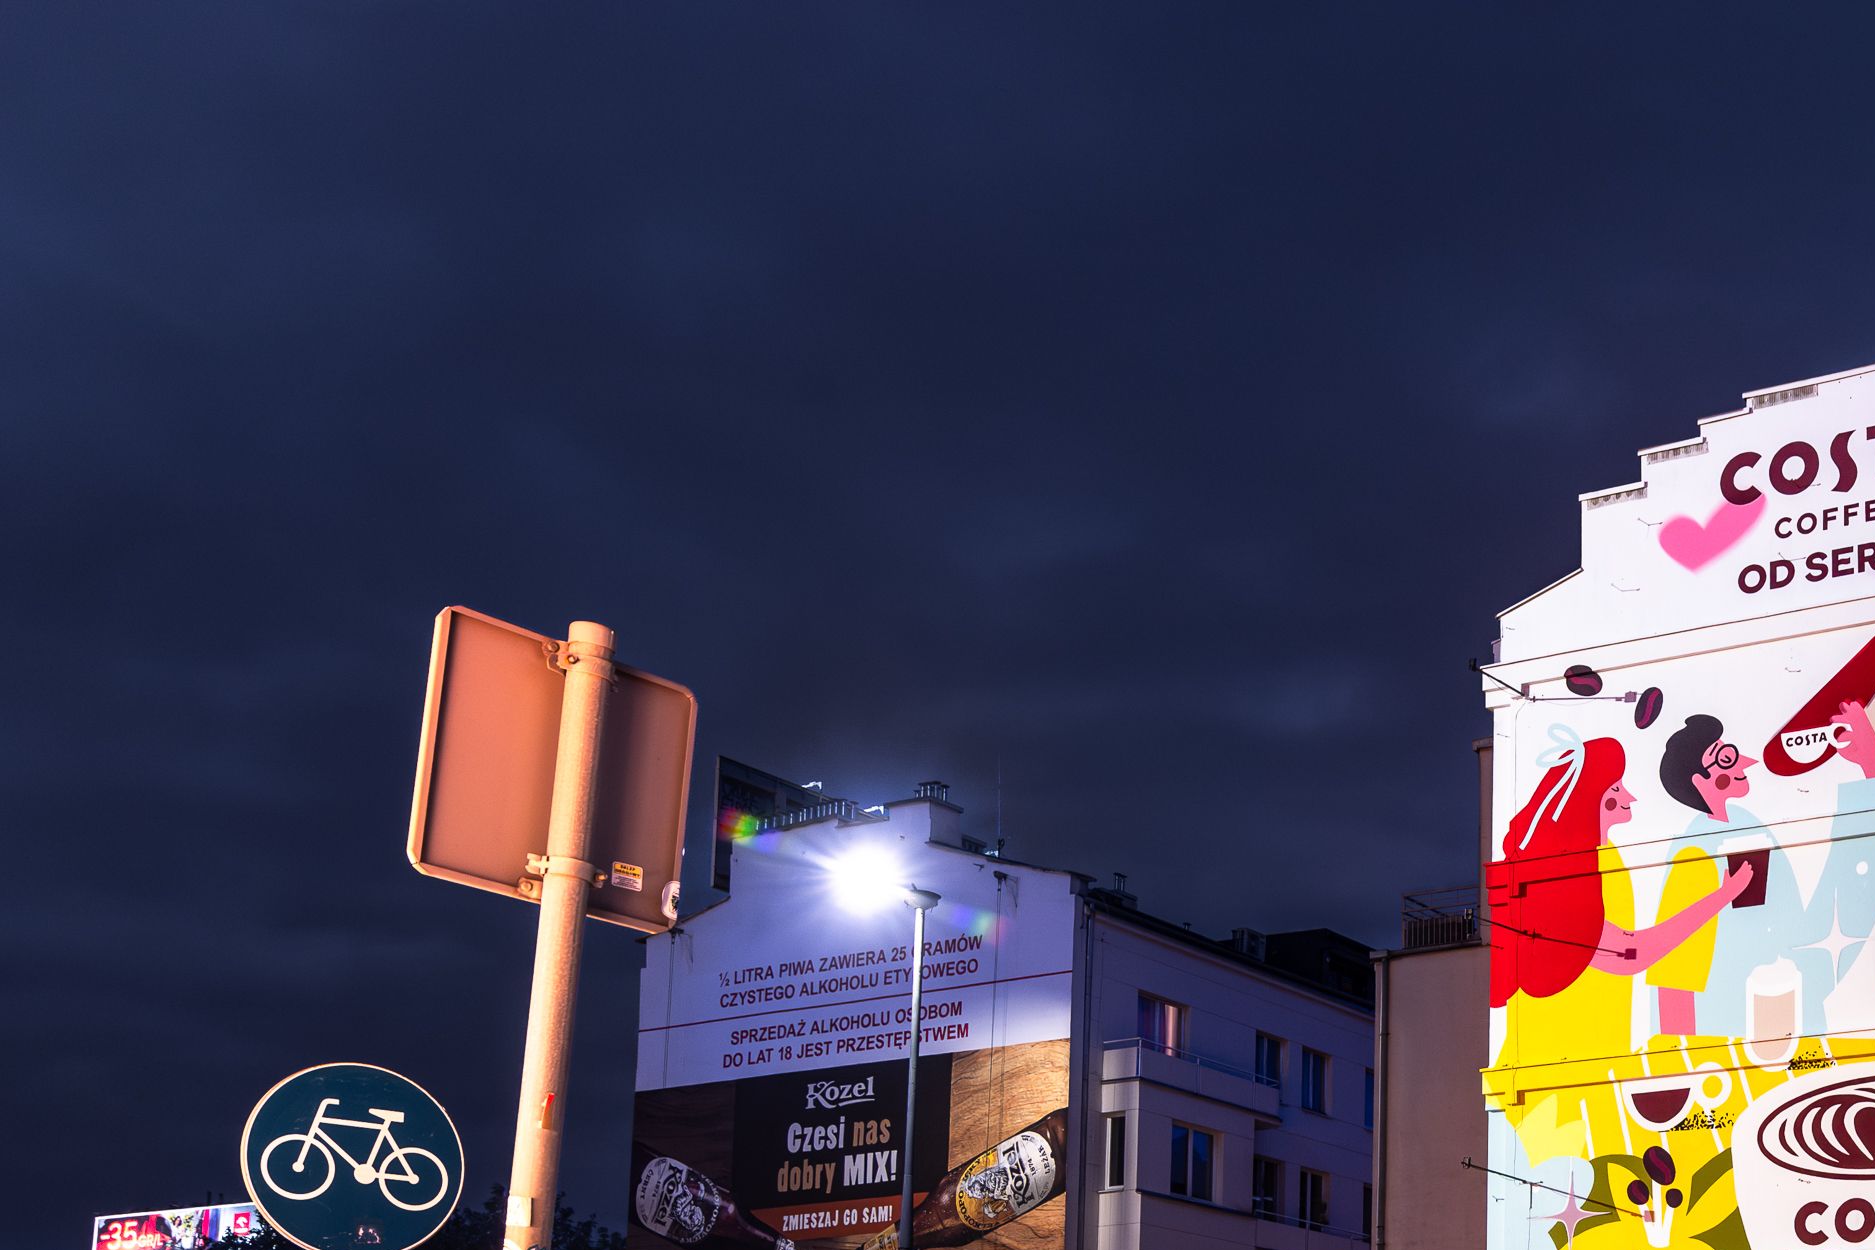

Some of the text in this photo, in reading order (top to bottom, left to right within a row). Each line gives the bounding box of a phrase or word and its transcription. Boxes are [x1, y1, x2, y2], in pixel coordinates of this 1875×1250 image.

[1738, 559, 1795, 594] OD
[1785, 732, 1828, 749] COSTA
[720, 958, 979, 1008] CZYSTEGO ALKOHOLU ETYOWEGO
[734, 965, 774, 985] LITRA
[779, 960, 814, 978] PIWA
[819, 950, 887, 973] ZAWIERA
[891, 946, 907, 962] 25
[731, 1019, 806, 1045] SPRZEDAŻ
[810, 1010, 890, 1036] ALKOHOLU
[723, 1052, 744, 1069] DO
[747, 1048, 774, 1065] LAT
[779, 1046, 793, 1061] 18
[797, 1041, 832, 1060] JEST
[805, 1076, 875, 1109] Kozel
[787, 1116, 891, 1153] Czesi nas
[777, 1150, 898, 1194] dobry MIX!
[1002, 1141, 1037, 1208] Kozel
[782, 1205, 893, 1232] ZMIESZAJ GO SAM!
